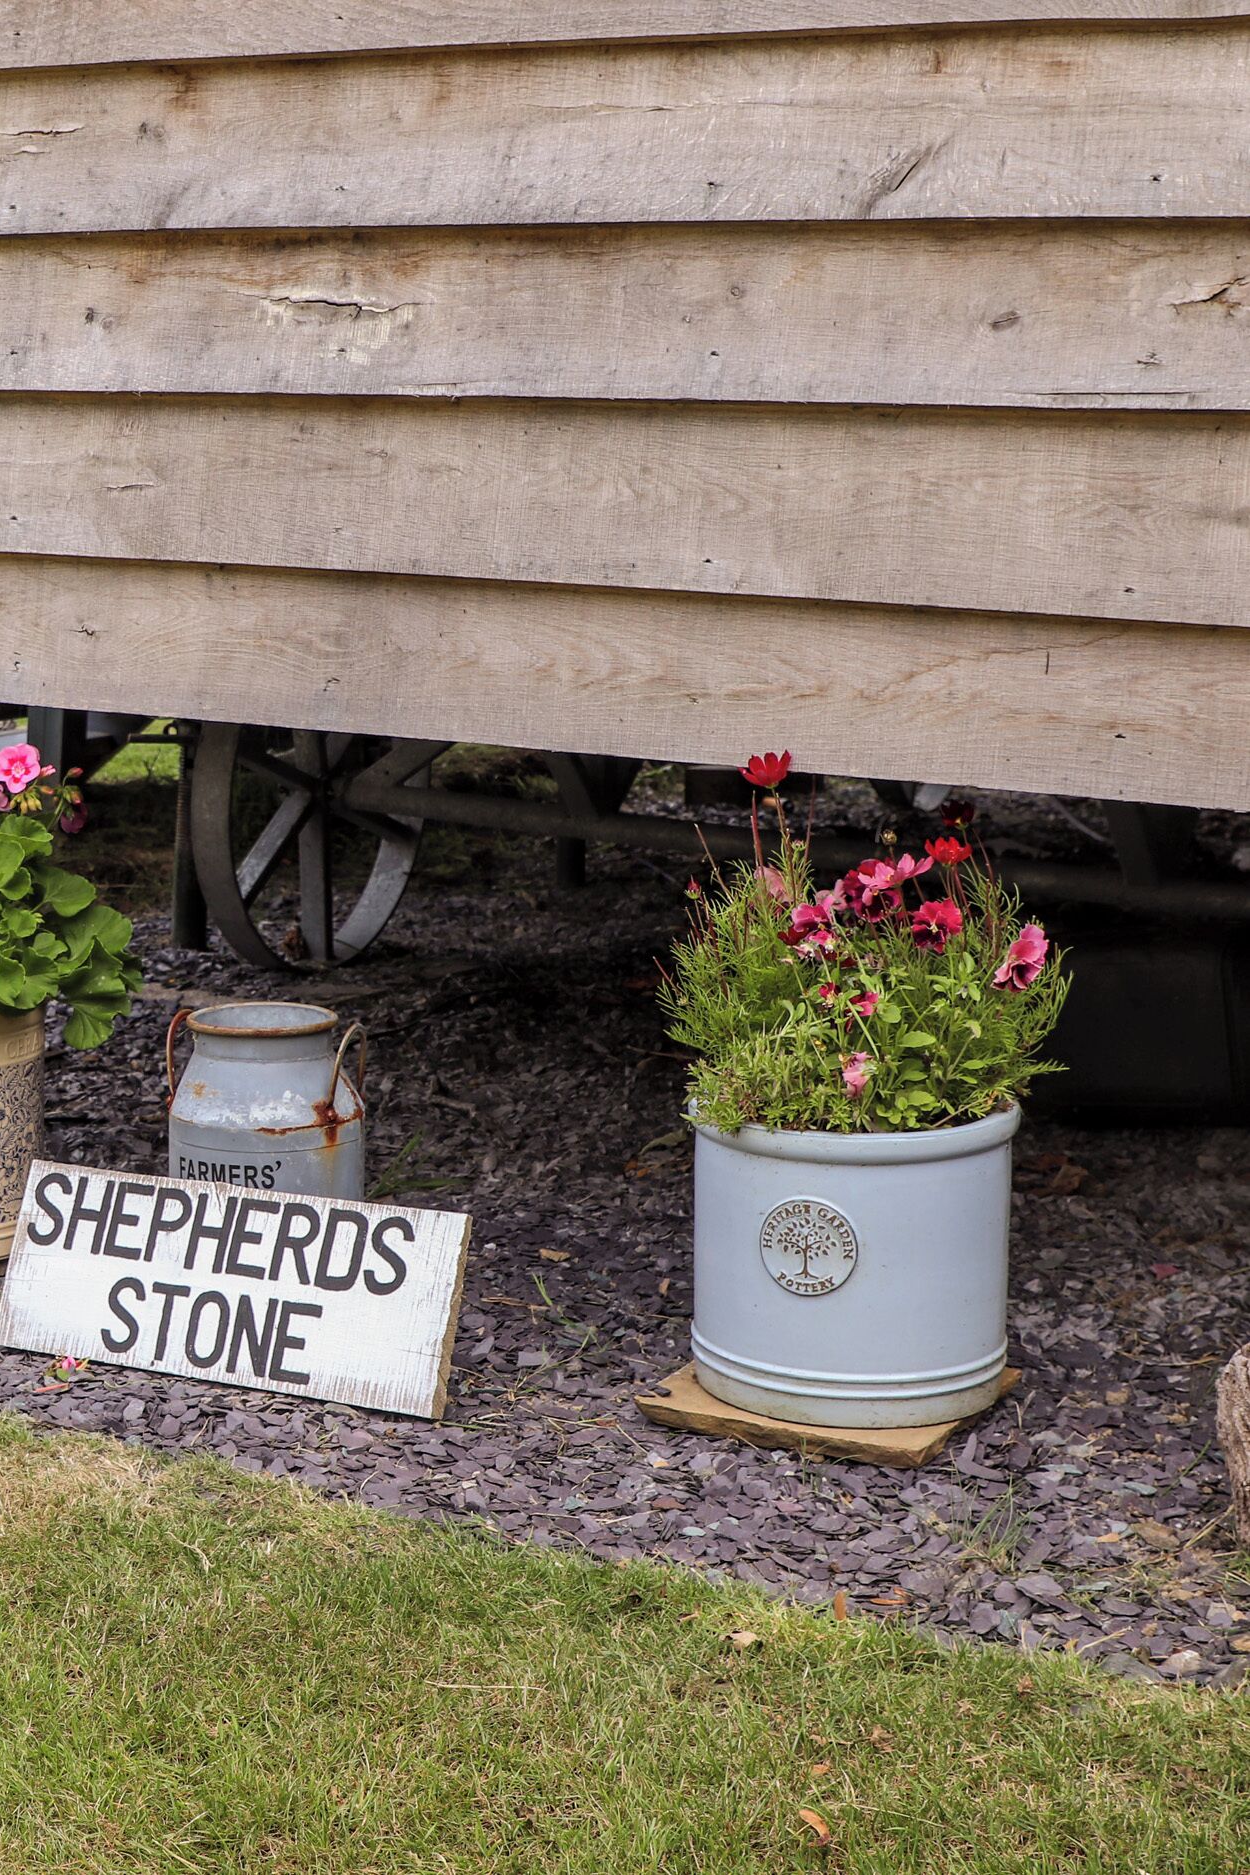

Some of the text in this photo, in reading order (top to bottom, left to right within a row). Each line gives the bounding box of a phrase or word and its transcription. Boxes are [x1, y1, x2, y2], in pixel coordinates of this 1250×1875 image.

[27, 1172, 416, 1296] SHEPHERDS
[762, 1203, 855, 1260] HERITAGE GARDEN
[776, 1271, 836, 1293] POTTERY
[100, 1276, 323, 1385] STONE
